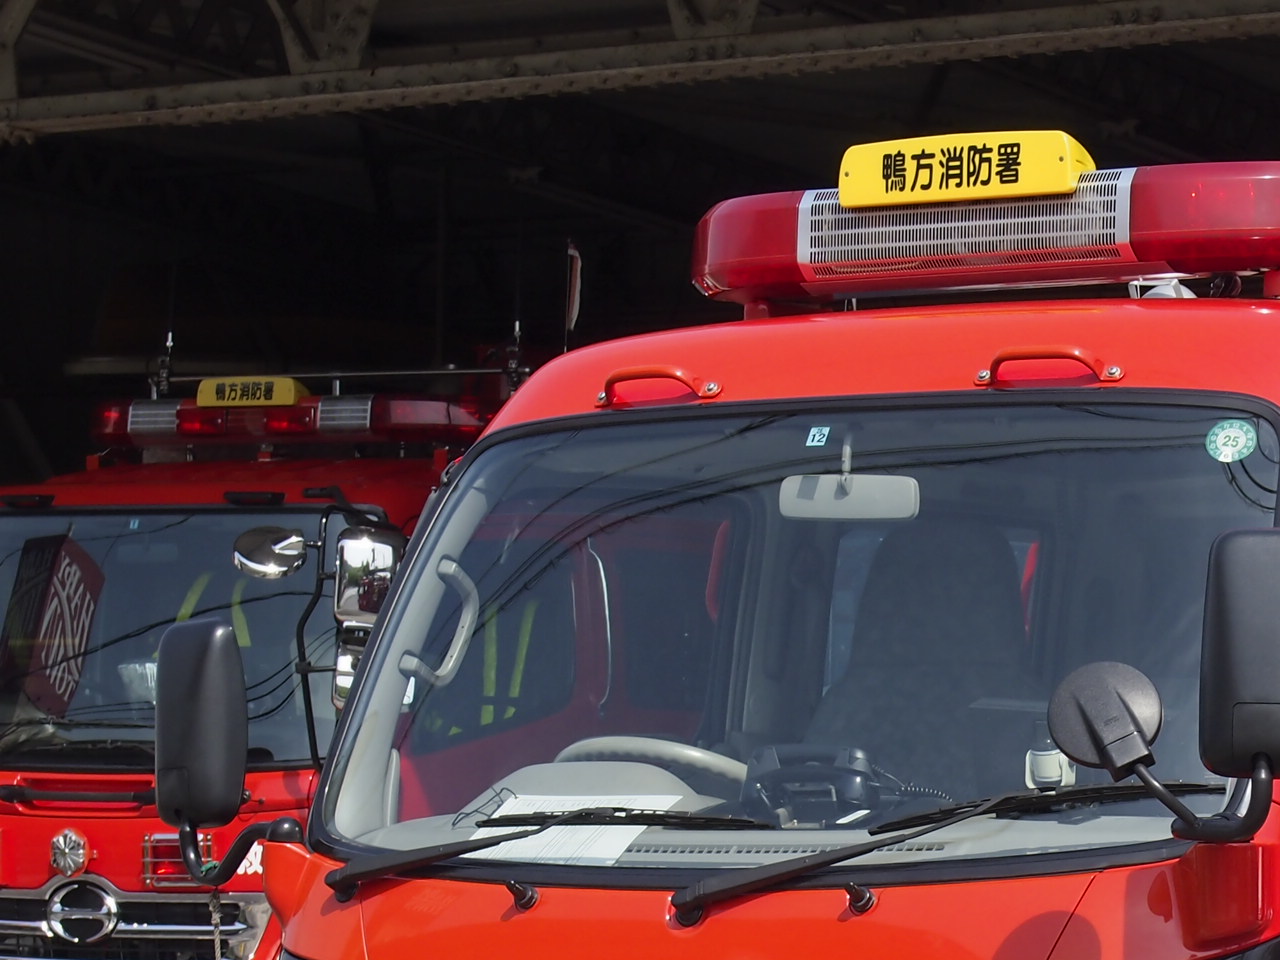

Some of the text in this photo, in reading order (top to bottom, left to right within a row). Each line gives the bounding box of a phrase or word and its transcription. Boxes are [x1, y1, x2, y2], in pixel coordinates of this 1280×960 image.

[882, 143, 1021, 193] 鴨方消防署
[215, 381, 274, 401] 鴨方消防署
[811, 433, 825, 443] 12
[1222, 435, 1240, 447] 25
